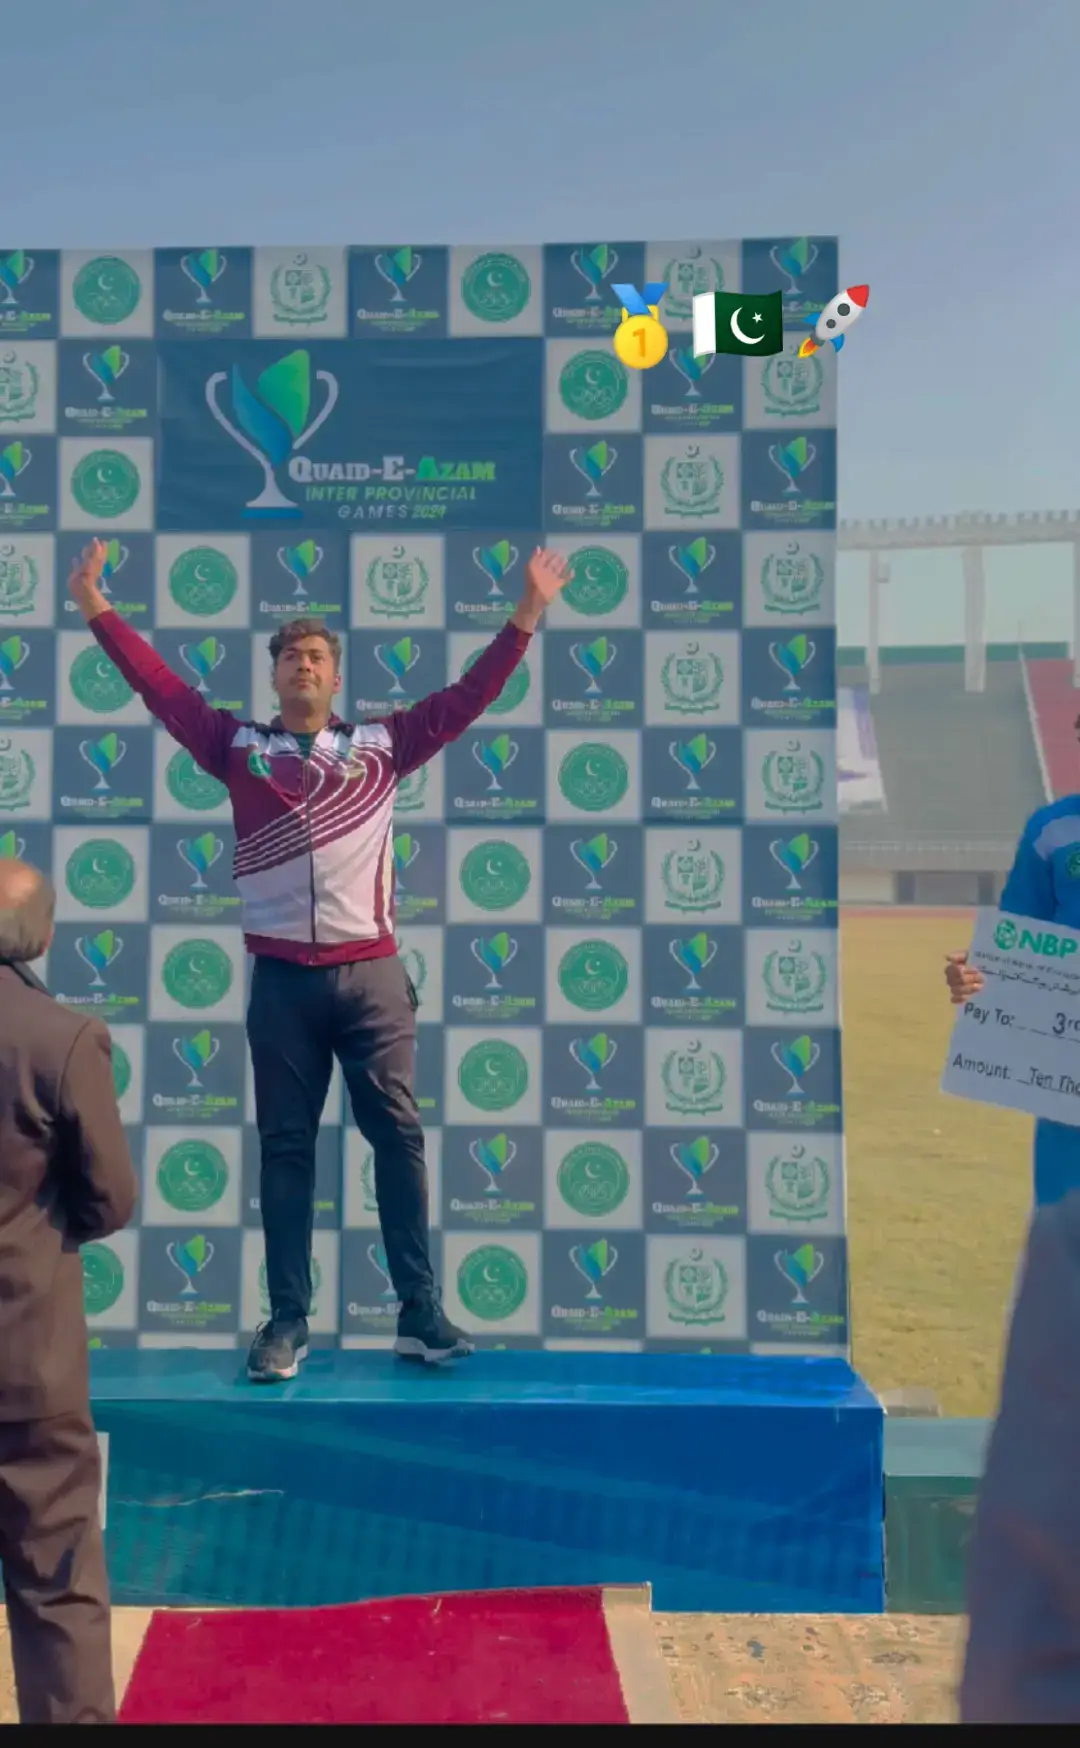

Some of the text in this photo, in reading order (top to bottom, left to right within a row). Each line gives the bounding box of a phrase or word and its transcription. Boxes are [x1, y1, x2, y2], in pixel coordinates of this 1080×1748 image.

[288, 455, 496, 483] QUAID-E-AZAM
[306, 486, 477, 501] INTER PROVINCIAL
[337, 505, 408, 519] GAMES
[1019, 929, 1078, 958] NBP
[964, 1002, 990, 1025] Pay
[1030, 1066, 1053, 1089] Ten
